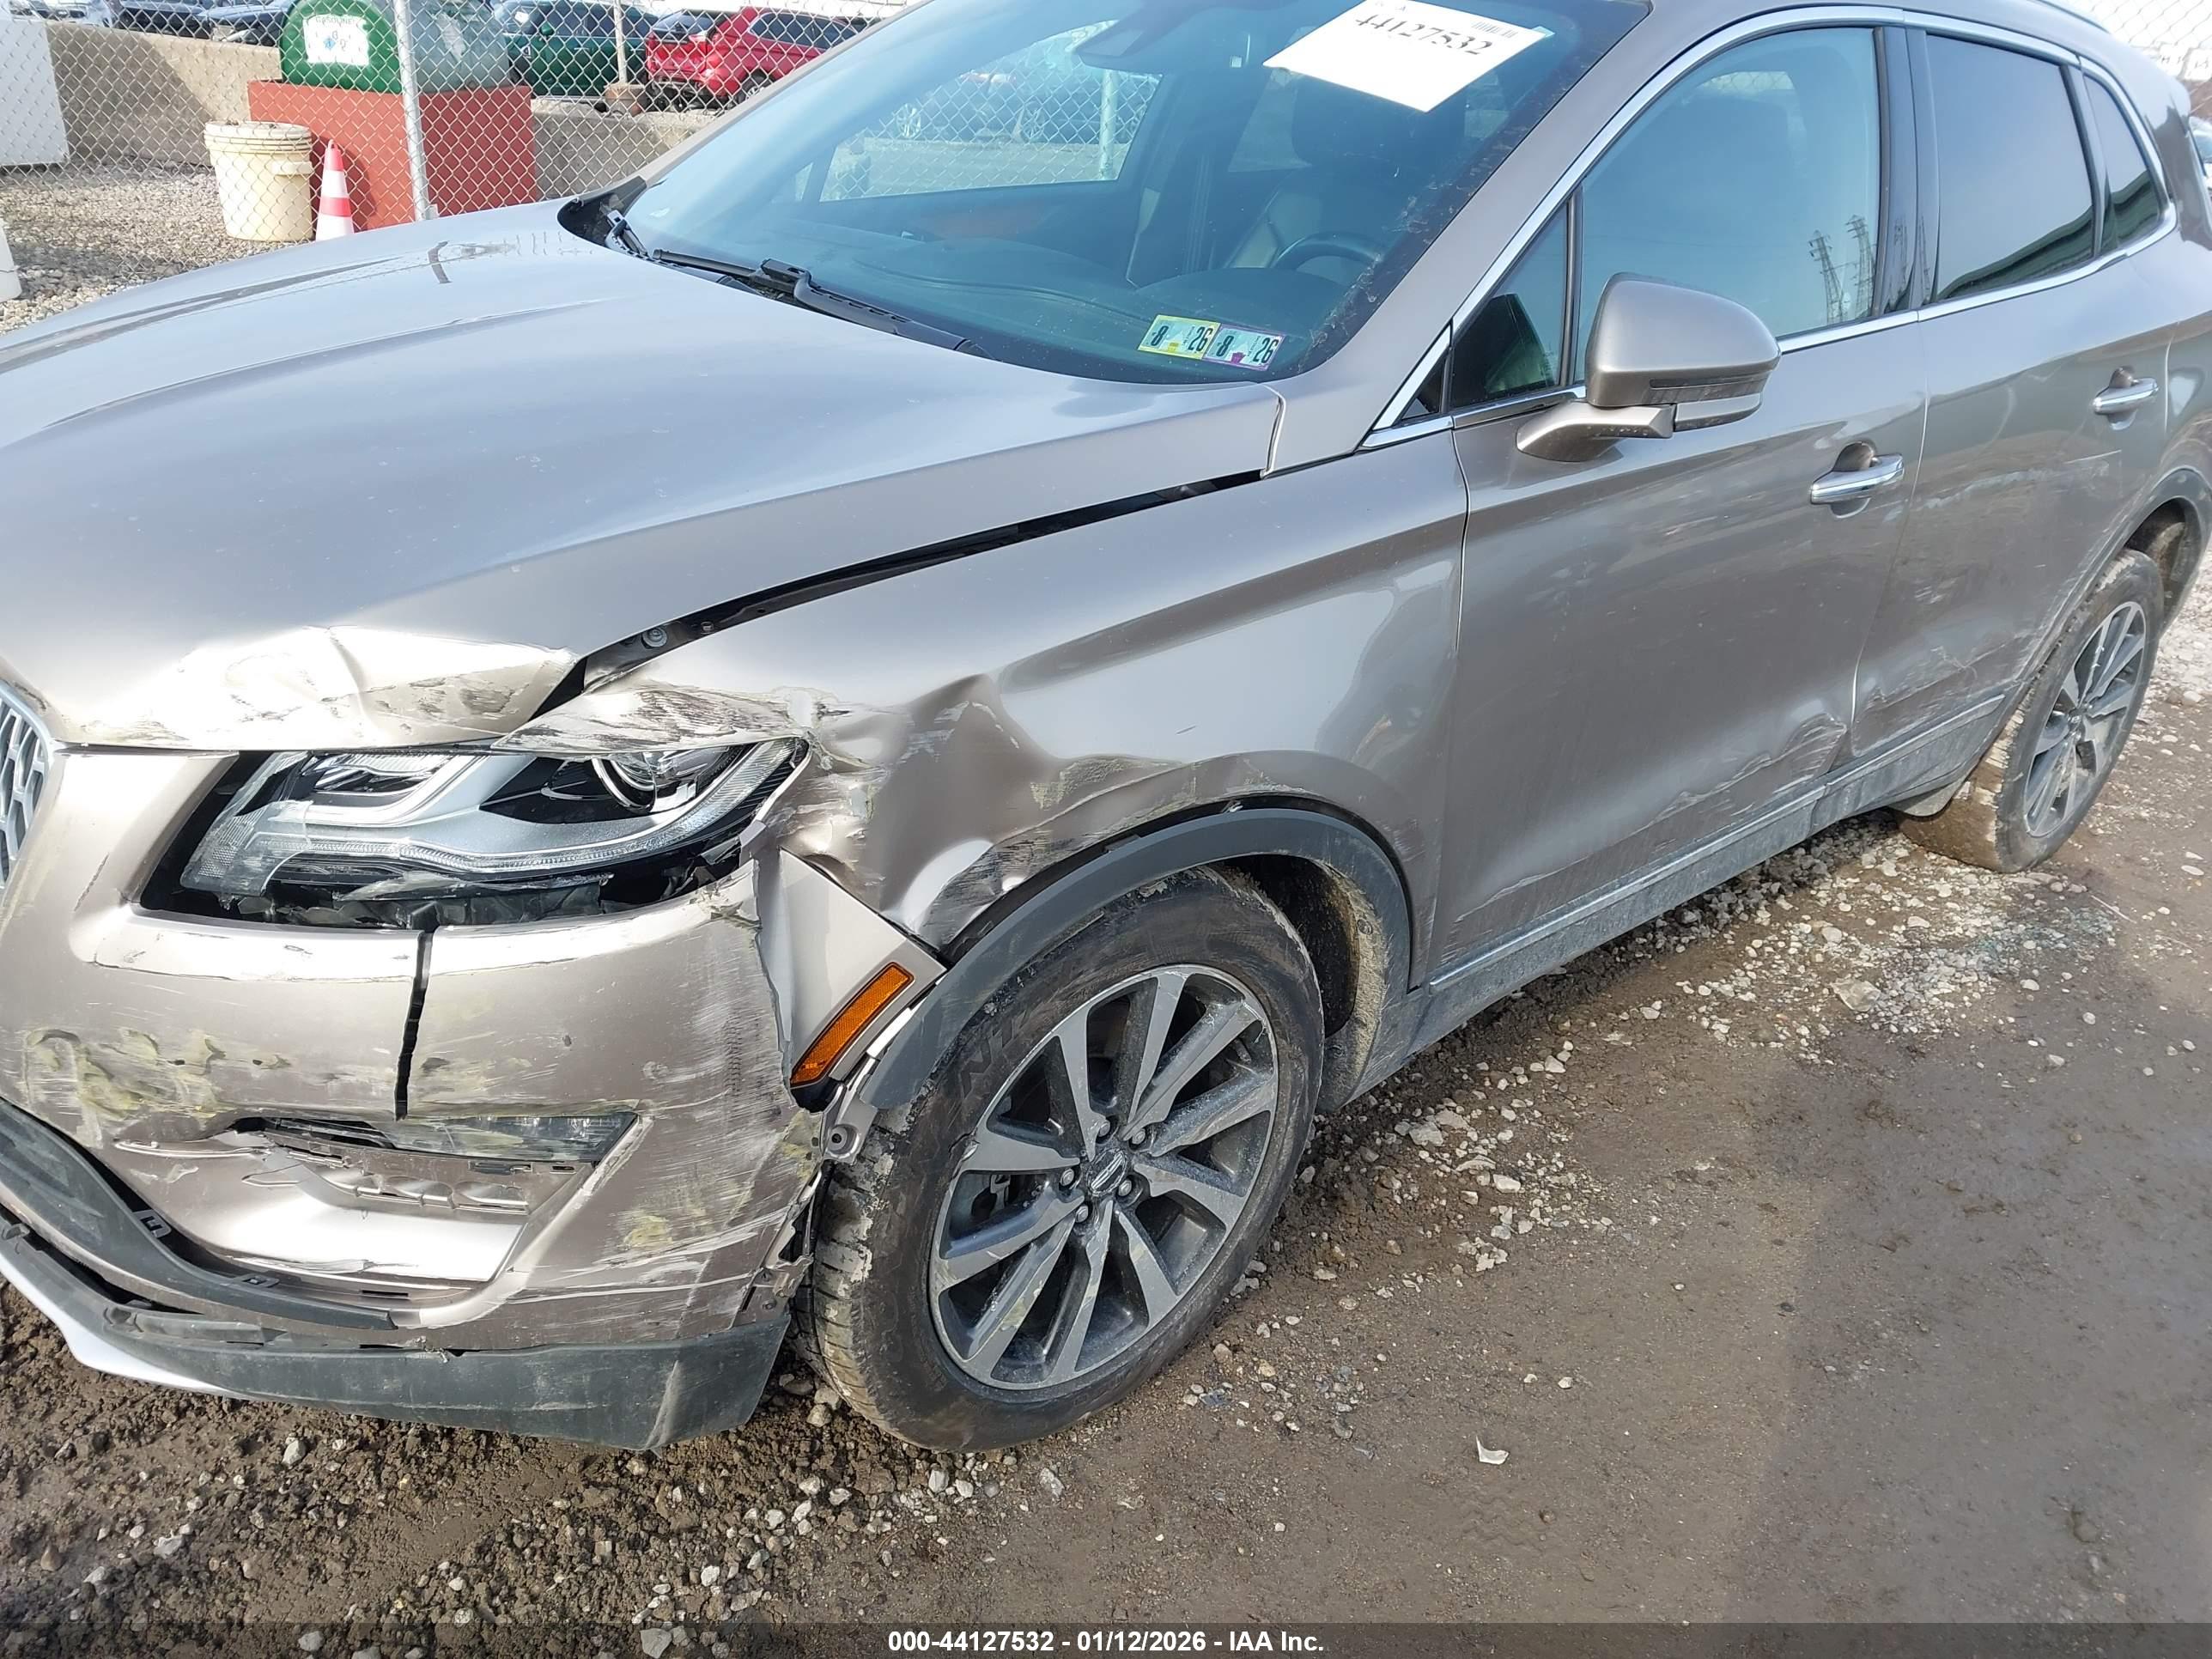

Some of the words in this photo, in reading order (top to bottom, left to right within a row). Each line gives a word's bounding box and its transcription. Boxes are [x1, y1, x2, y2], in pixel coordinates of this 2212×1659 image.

[1355, 14, 1492, 55] 44127532
[1151, 325, 1169, 346] 8
[1188, 326, 1212, 352] 26
[1216, 335, 1235, 357] 8
[1253, 337, 1278, 363] 26
